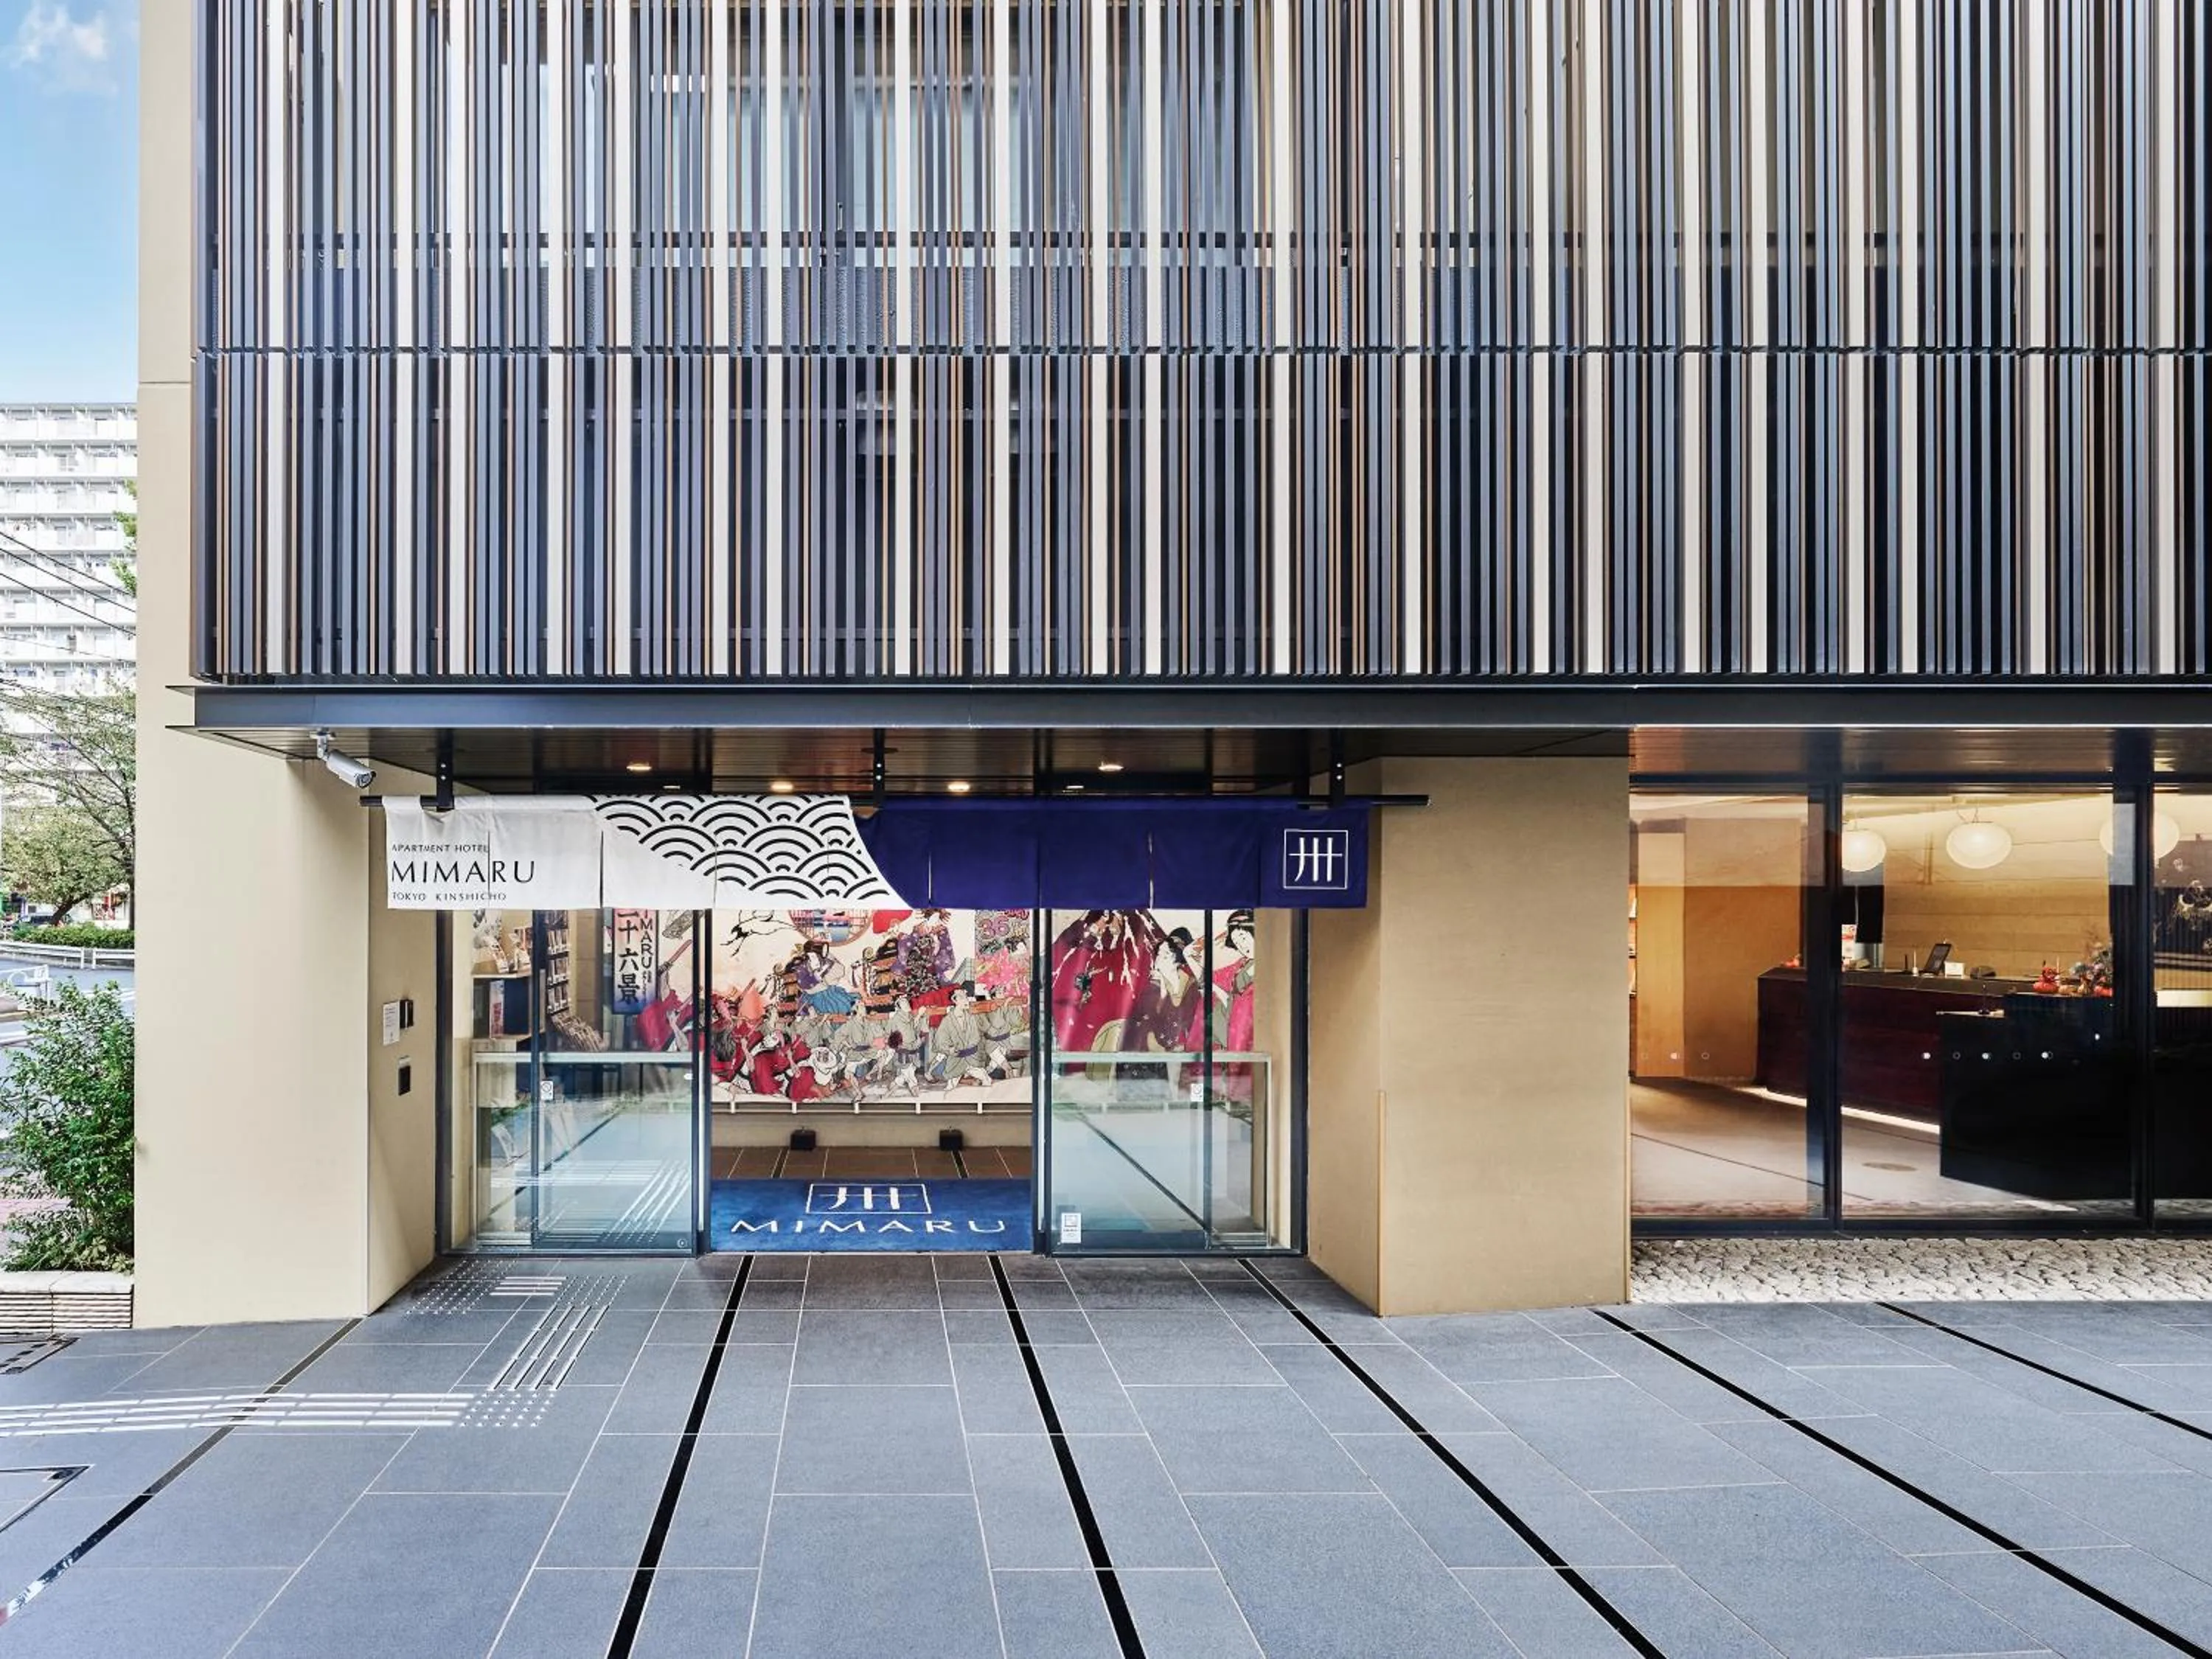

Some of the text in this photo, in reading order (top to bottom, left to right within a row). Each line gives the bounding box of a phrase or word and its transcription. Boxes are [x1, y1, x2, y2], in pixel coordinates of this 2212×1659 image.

[392, 844, 490, 853] APARTMENT HOTEL
[392, 860, 535, 884] MIMARU
[392, 891, 507, 902] TOKYO KINSHICHO
[731, 1220, 1006, 1234] MIMARU
